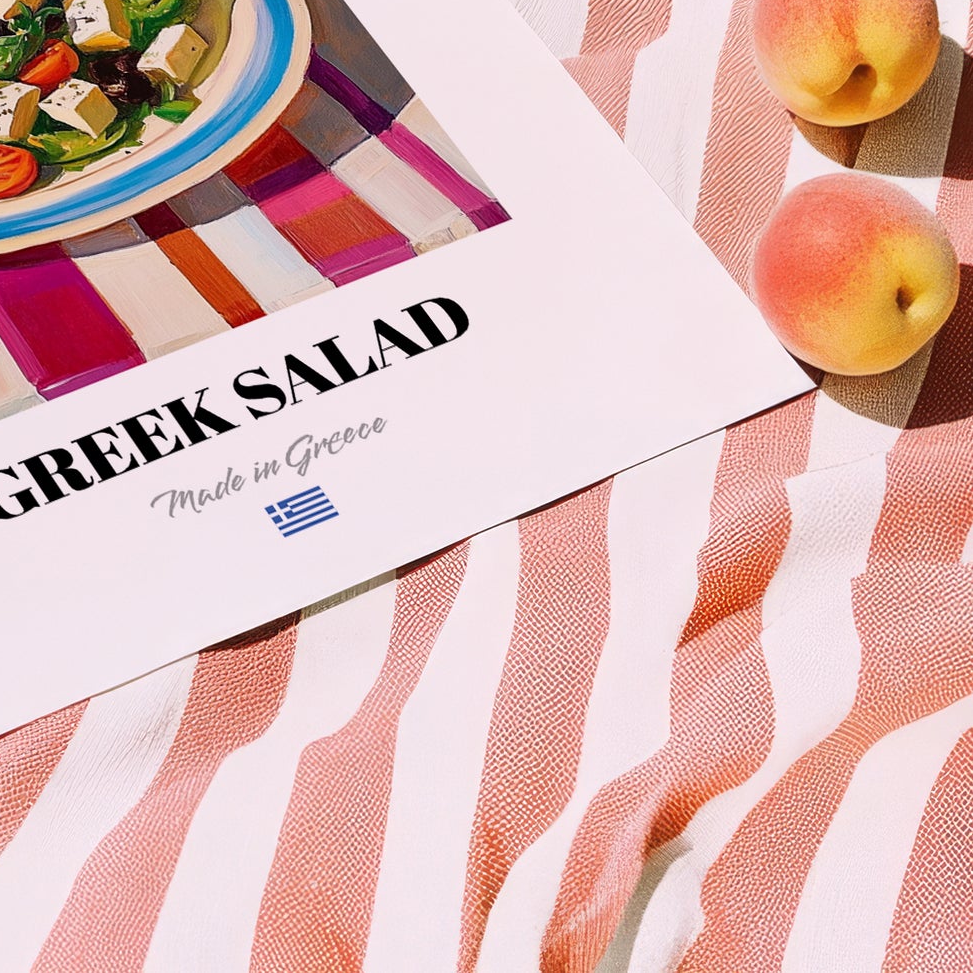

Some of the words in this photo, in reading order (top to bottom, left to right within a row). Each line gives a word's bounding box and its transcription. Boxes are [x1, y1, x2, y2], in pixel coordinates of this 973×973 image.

[232, 296, 470, 420] SALAD
[150, 467, 247, 519] Made
[253, 459, 283, 484] in
[284, 416, 388, 478] Greece
